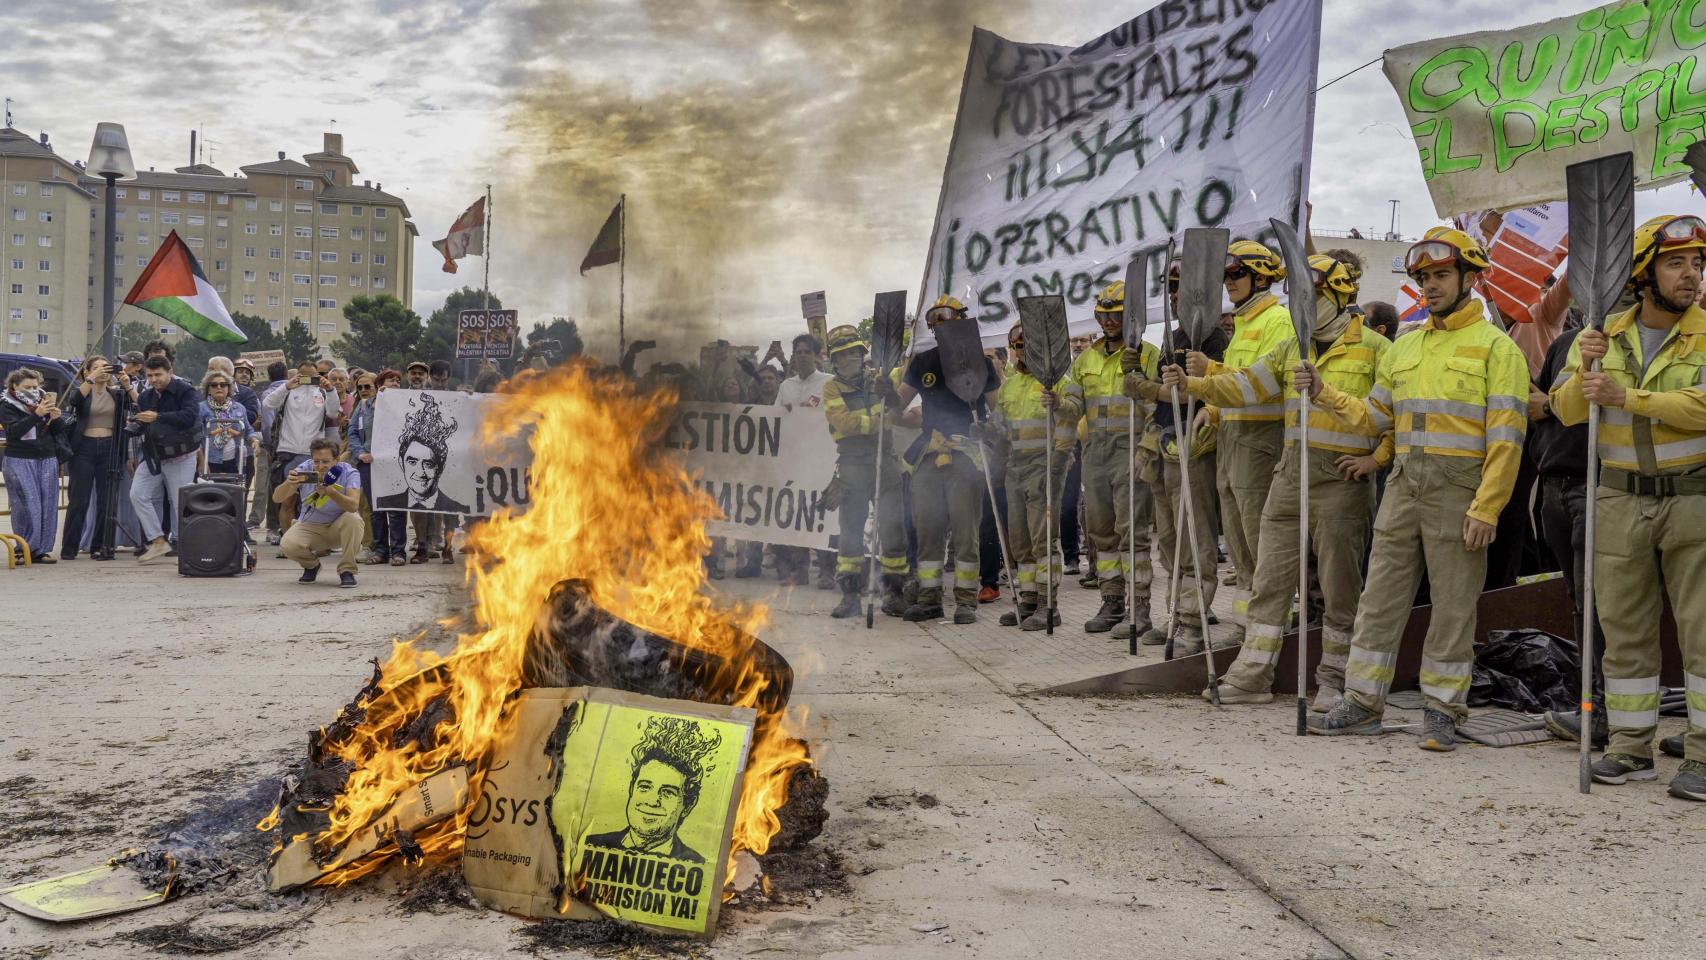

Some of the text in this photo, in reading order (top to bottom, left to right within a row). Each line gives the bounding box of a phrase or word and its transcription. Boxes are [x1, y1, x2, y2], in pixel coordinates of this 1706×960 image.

[461, 314, 485, 328] SOS
[489, 314, 513, 328] SOS
[663, 406, 782, 457] ESTIÓN
[475, 466, 530, 513] ¡QU
[488, 849, 532, 867] Packaging
[580, 849, 704, 897] MAÑUECO
[670, 895, 699, 921] YA!
